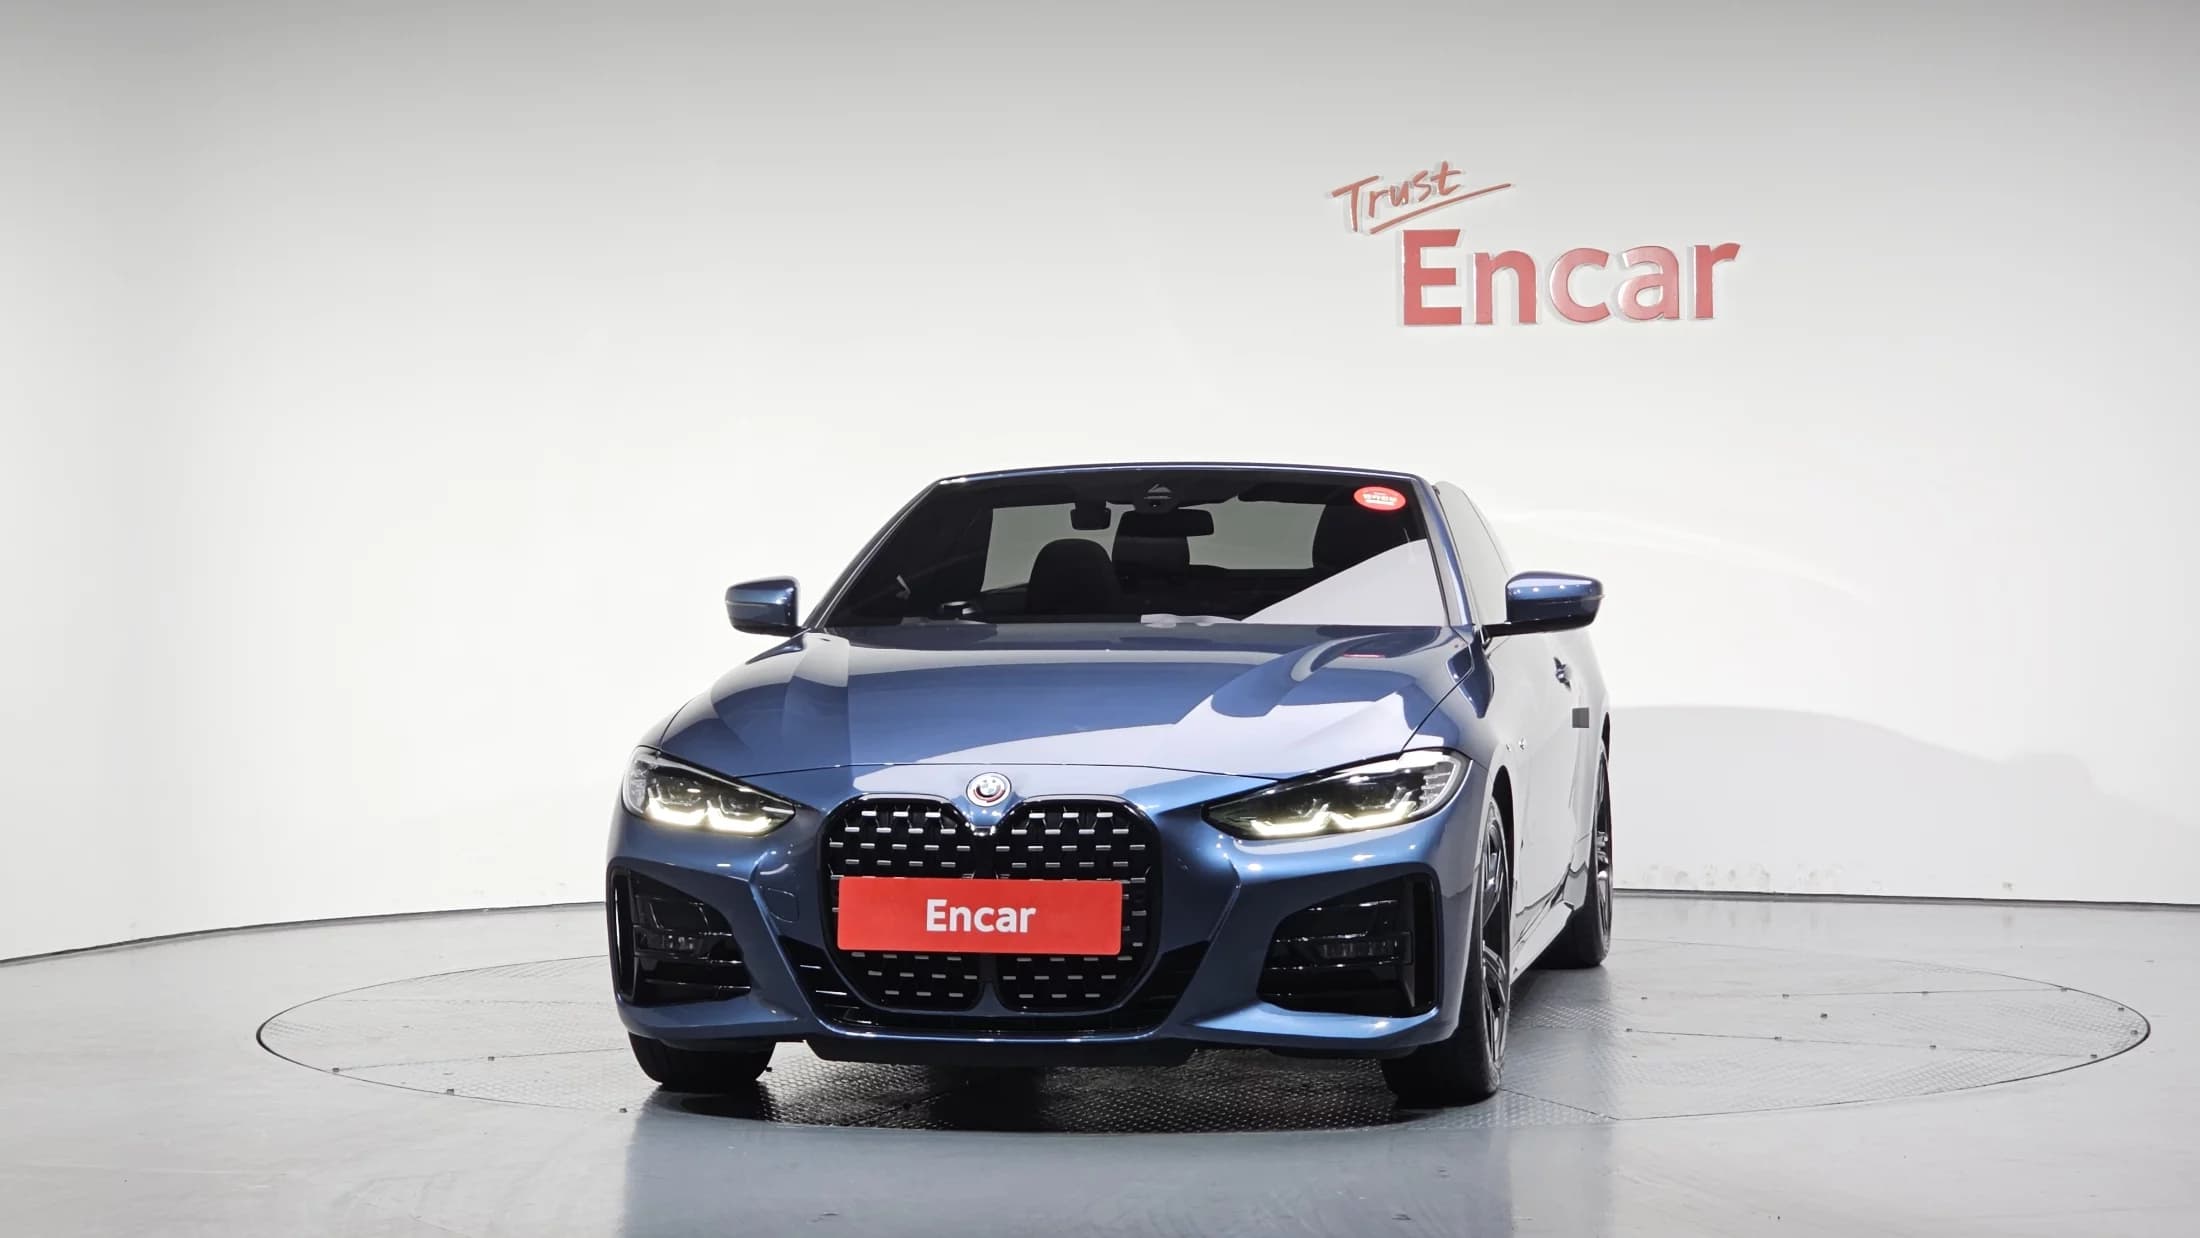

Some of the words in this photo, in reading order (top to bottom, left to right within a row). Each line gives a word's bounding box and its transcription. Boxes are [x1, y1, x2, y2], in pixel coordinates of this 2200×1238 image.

[1332, 160, 1462, 232] Trust
[1402, 229, 1740, 325] Encar
[926, 898, 1036, 933] Encar
